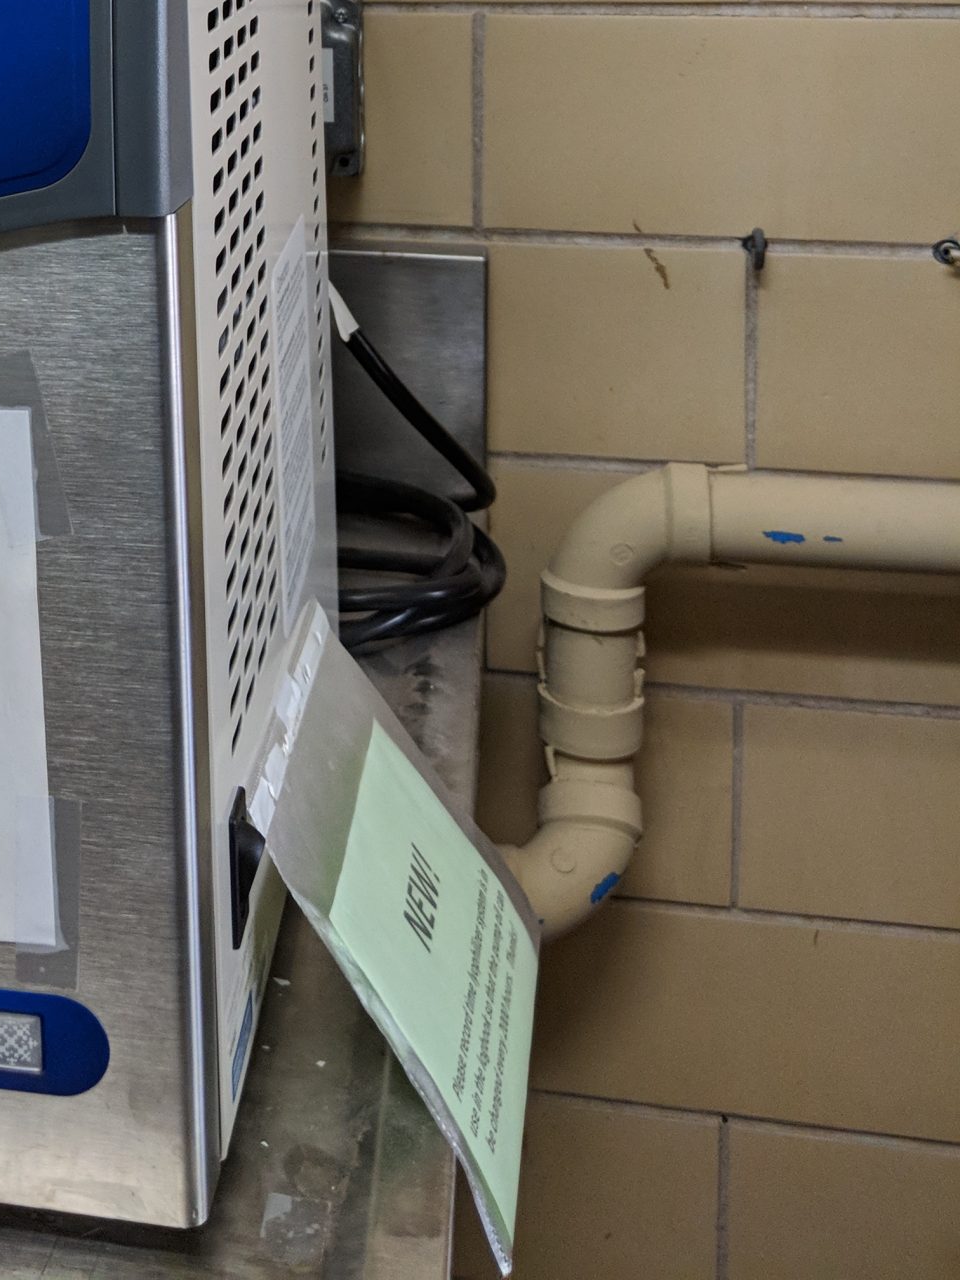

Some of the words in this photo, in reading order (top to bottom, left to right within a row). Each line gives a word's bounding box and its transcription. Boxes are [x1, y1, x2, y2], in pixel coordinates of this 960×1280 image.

[403, 841, 440, 953] NEW!
[463, 982, 476, 1015] time
[460, 1004, 472, 1058] record
[452, 1055, 466, 1103] Please
[474, 1067, 484, 1095] the
[472, 1092, 481, 1112] in
[470, 1108, 479, 1138] use
[485, 1130, 496, 1153] be
